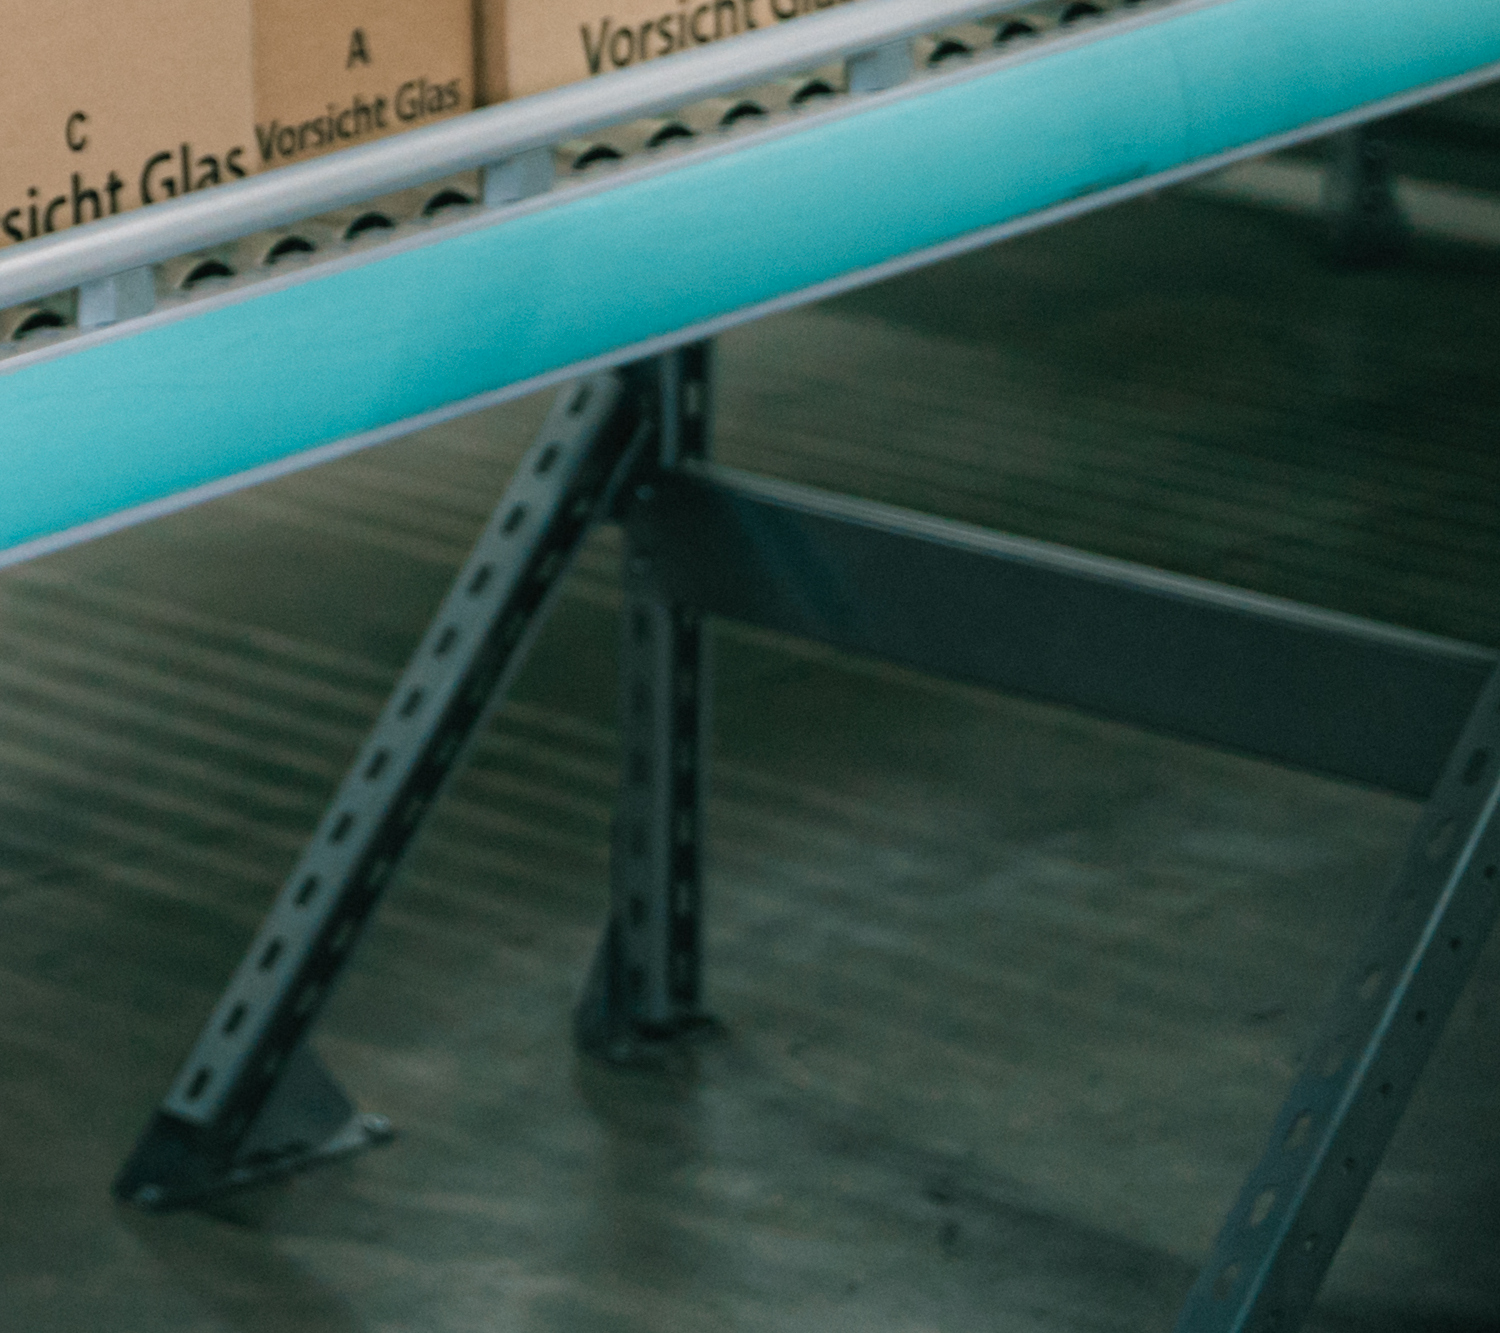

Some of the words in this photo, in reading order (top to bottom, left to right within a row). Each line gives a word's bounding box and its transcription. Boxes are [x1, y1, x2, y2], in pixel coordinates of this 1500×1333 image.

[347, 27, 371, 69] A
[65, 110, 88, 151] C
[255, 93, 387, 162] Vorsicht
[394, 75, 460, 122] Glas
[140, 142, 246, 204] Glas
